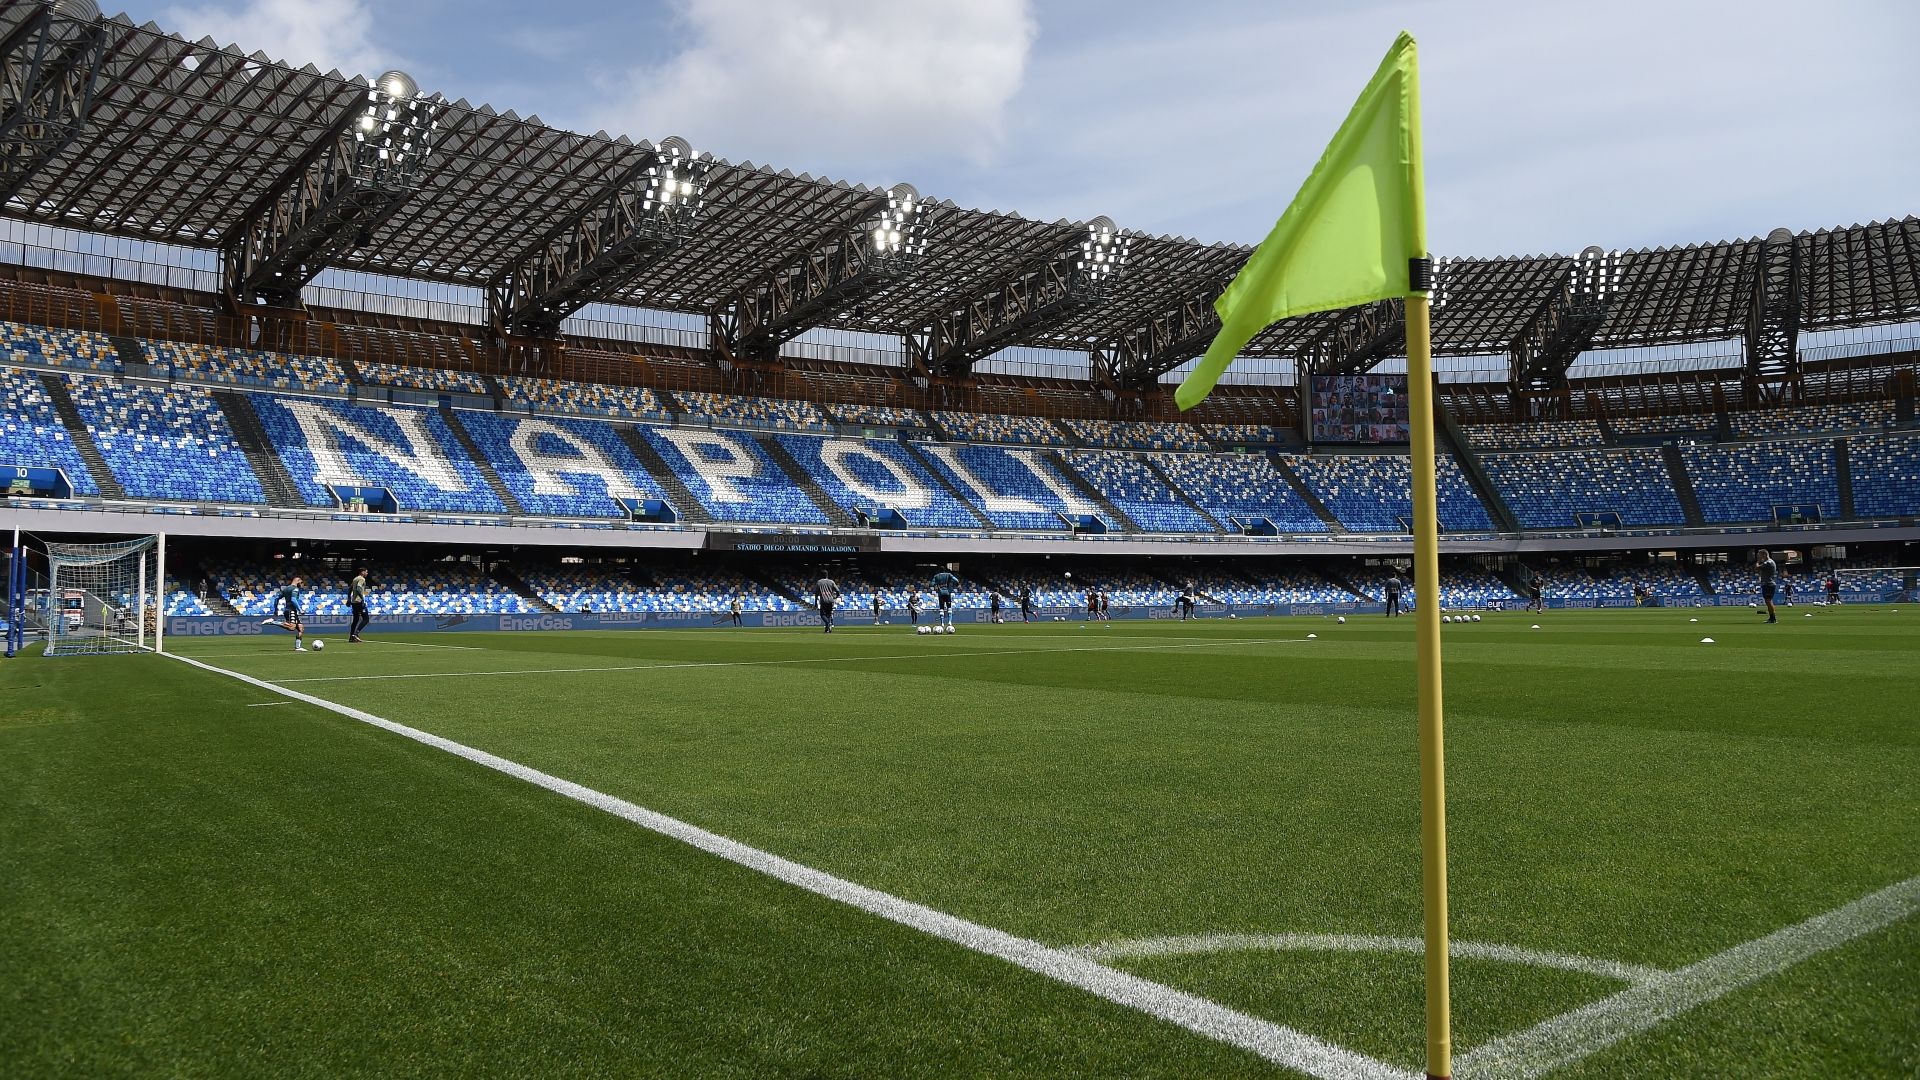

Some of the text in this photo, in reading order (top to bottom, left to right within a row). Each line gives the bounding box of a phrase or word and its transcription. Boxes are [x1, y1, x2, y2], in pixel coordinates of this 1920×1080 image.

[274, 398, 1103, 514] NAPOLI
[15, 468, 28, 478] 10
[354, 487, 361, 496] 11
[636, 500, 644, 508] 12
[821, 545, 856, 553] MARADONA
[1664, 596, 1714, 608] EnerGas
[1290, 605, 1323, 615] EnerGas
[501, 615, 572, 631] EnerGas
[763, 612, 821, 627] EnerGas
[171, 617, 263, 635] EnerGas
